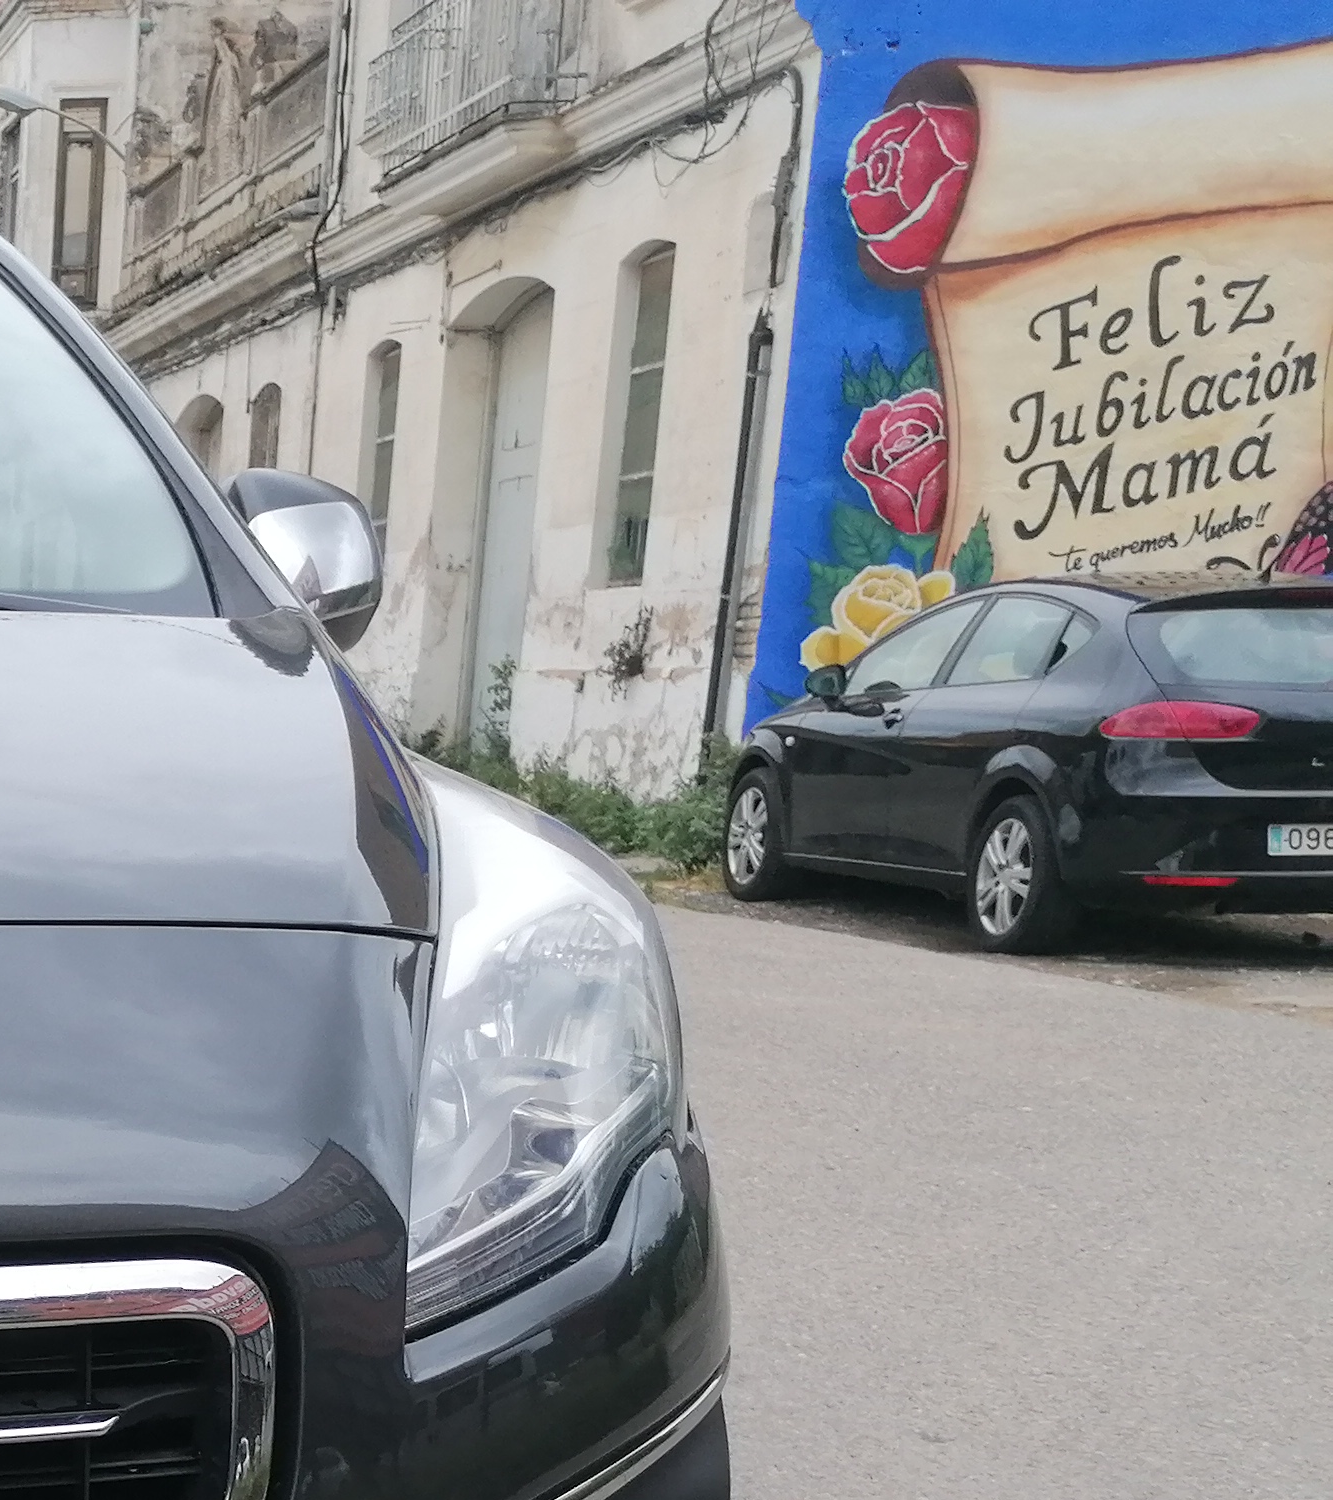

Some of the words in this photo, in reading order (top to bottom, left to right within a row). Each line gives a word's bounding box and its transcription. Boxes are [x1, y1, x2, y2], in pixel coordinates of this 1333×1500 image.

[1028, 254, 1276, 371] Feliz
[1003, 340, 1317, 464] Jubilación
[1013, 412, 1278, 541] Mamá
[1089, 531, 1179, 575] queremos
